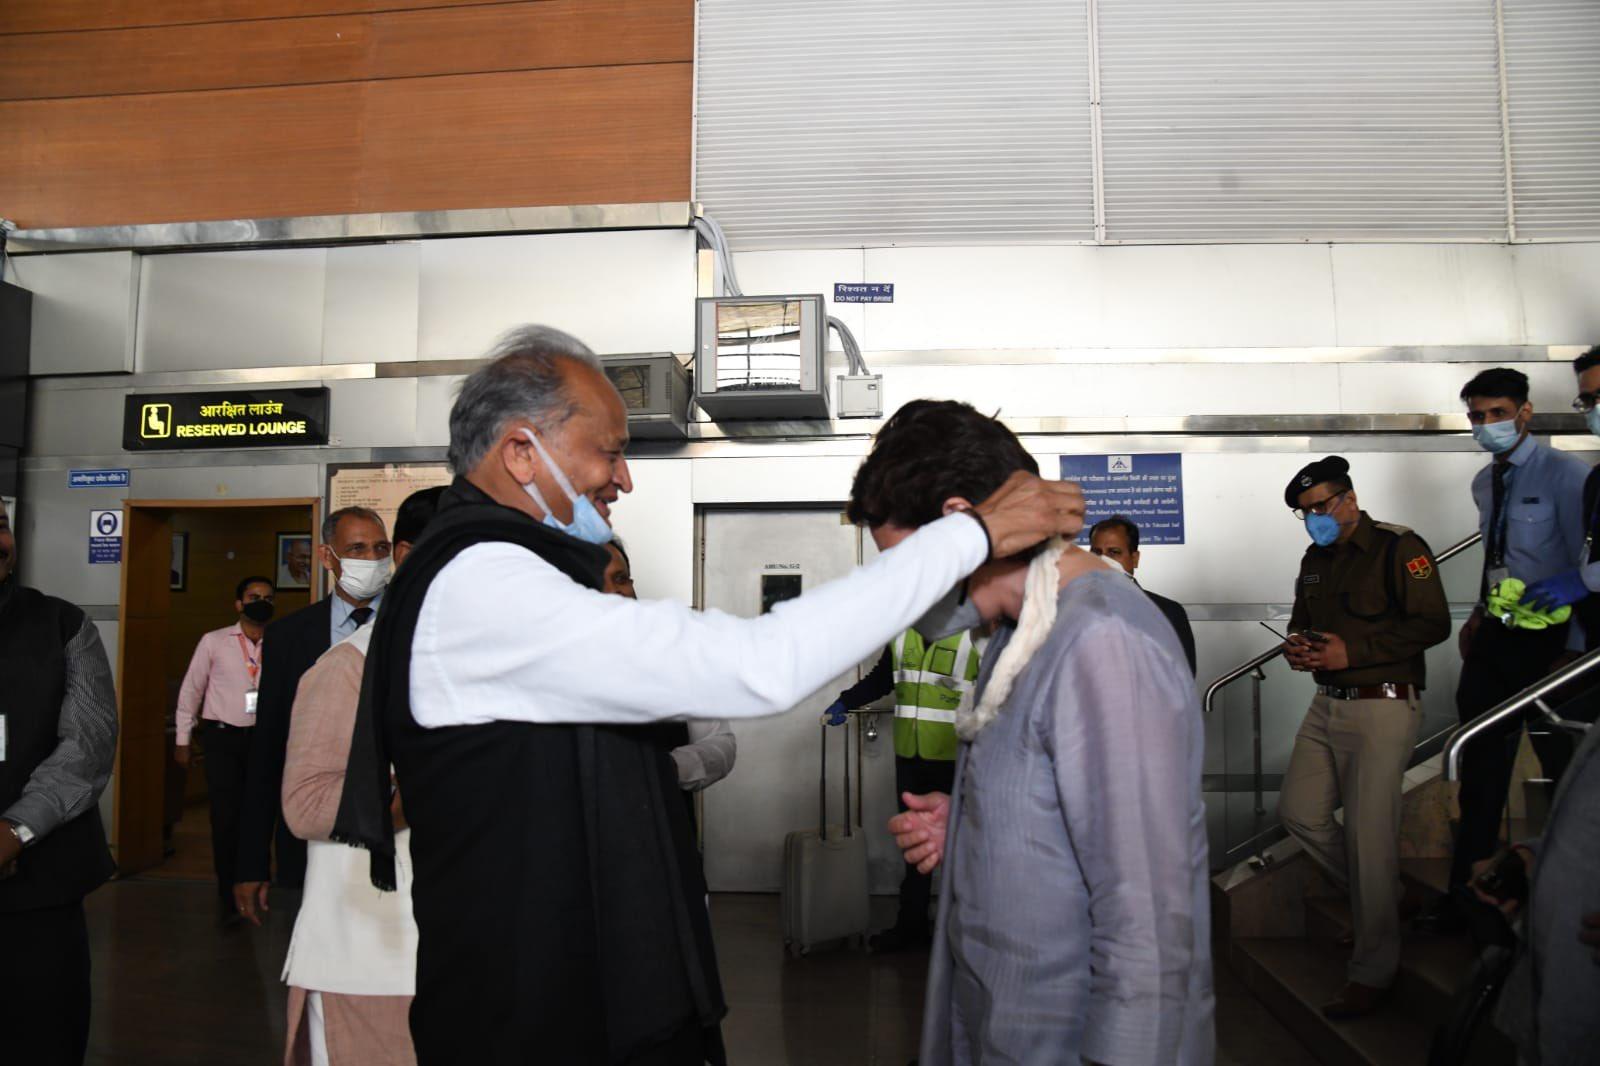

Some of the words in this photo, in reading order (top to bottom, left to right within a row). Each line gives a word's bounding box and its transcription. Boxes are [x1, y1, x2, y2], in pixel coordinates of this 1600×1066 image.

[838, 284, 867, 292] रिश्वत
[200, 400, 246, 418] आरक्षित
[249, 400, 284, 417] लाउंज
[176, 423, 247, 437] RESERVED
[249, 420, 307, 435] LOUNGE
